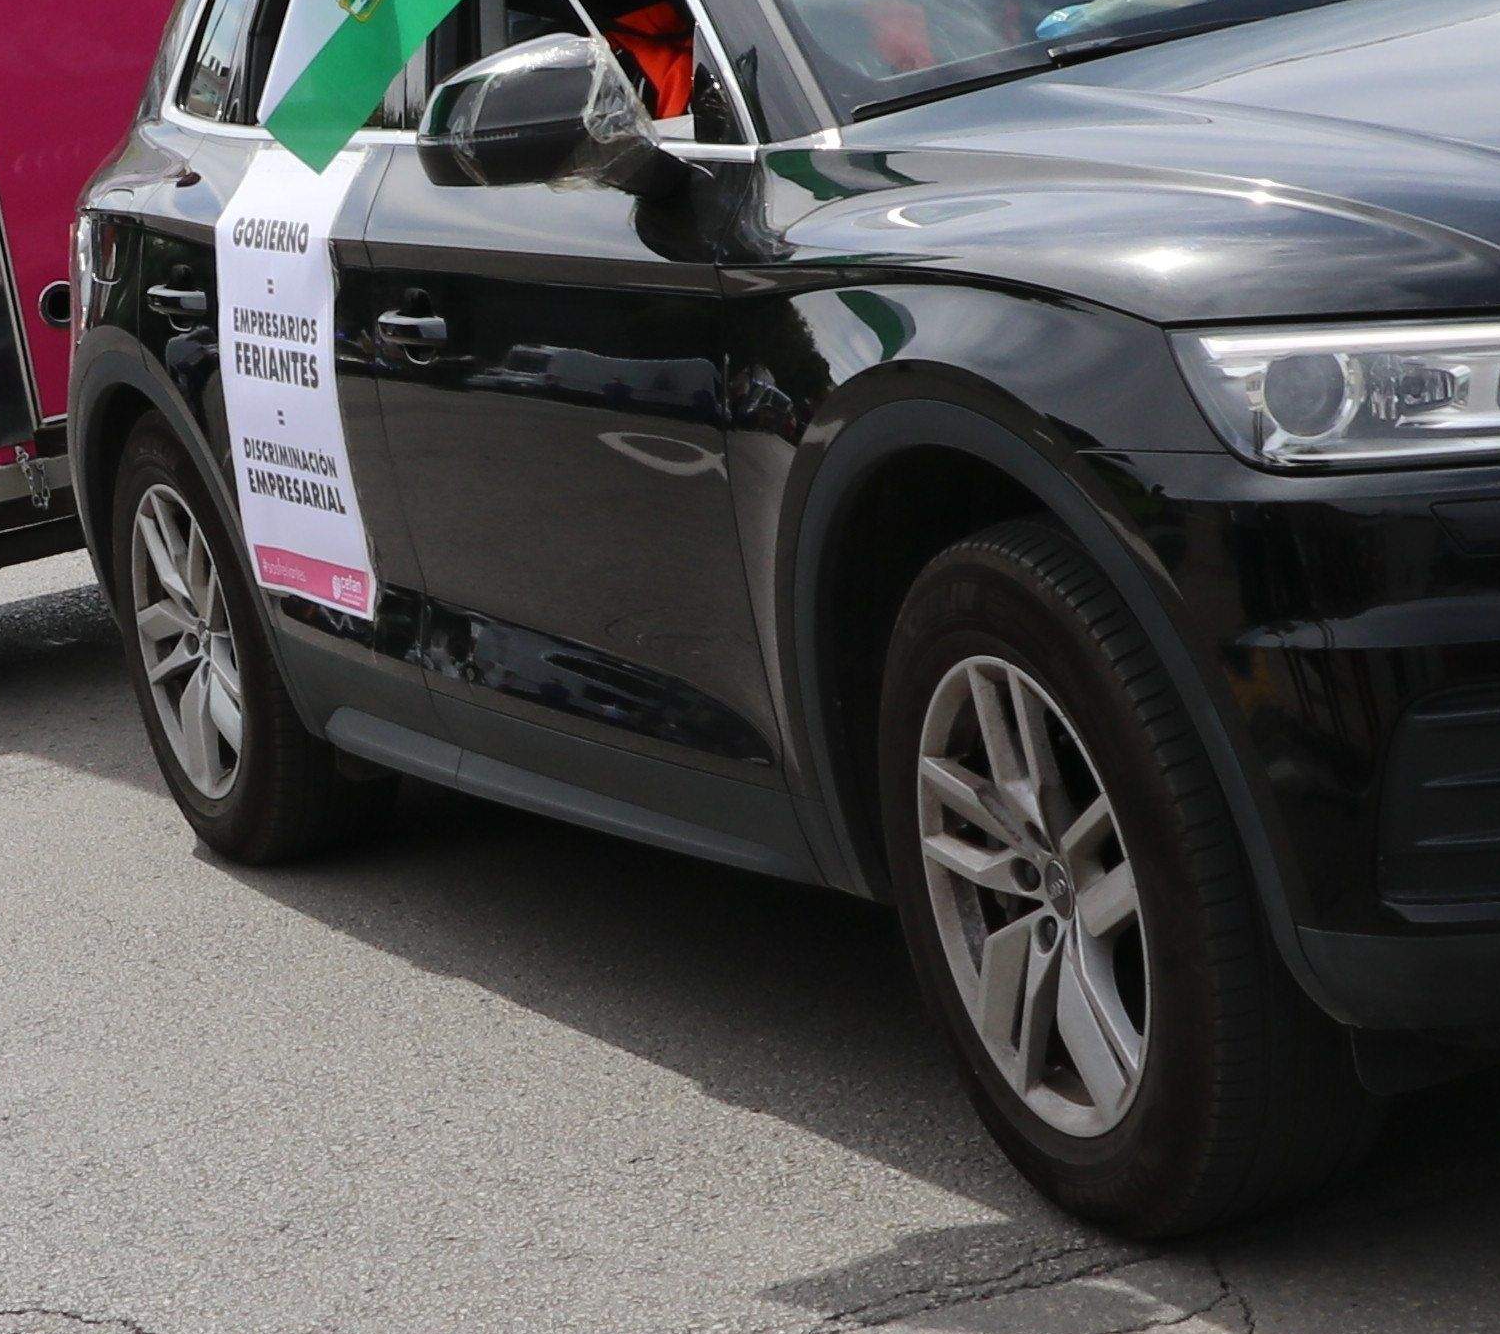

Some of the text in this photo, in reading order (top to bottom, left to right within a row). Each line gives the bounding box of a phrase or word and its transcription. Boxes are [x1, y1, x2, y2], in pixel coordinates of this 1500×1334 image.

[233, 218, 310, 255] GOBIERNO
[233, 307, 318, 345] EMPRESARIOS
[235, 341, 320, 389] FERIANTES
[242, 437, 339, 479] DISCRIMINACIÓN
[247, 466, 347, 515] EMPRESARIAL
